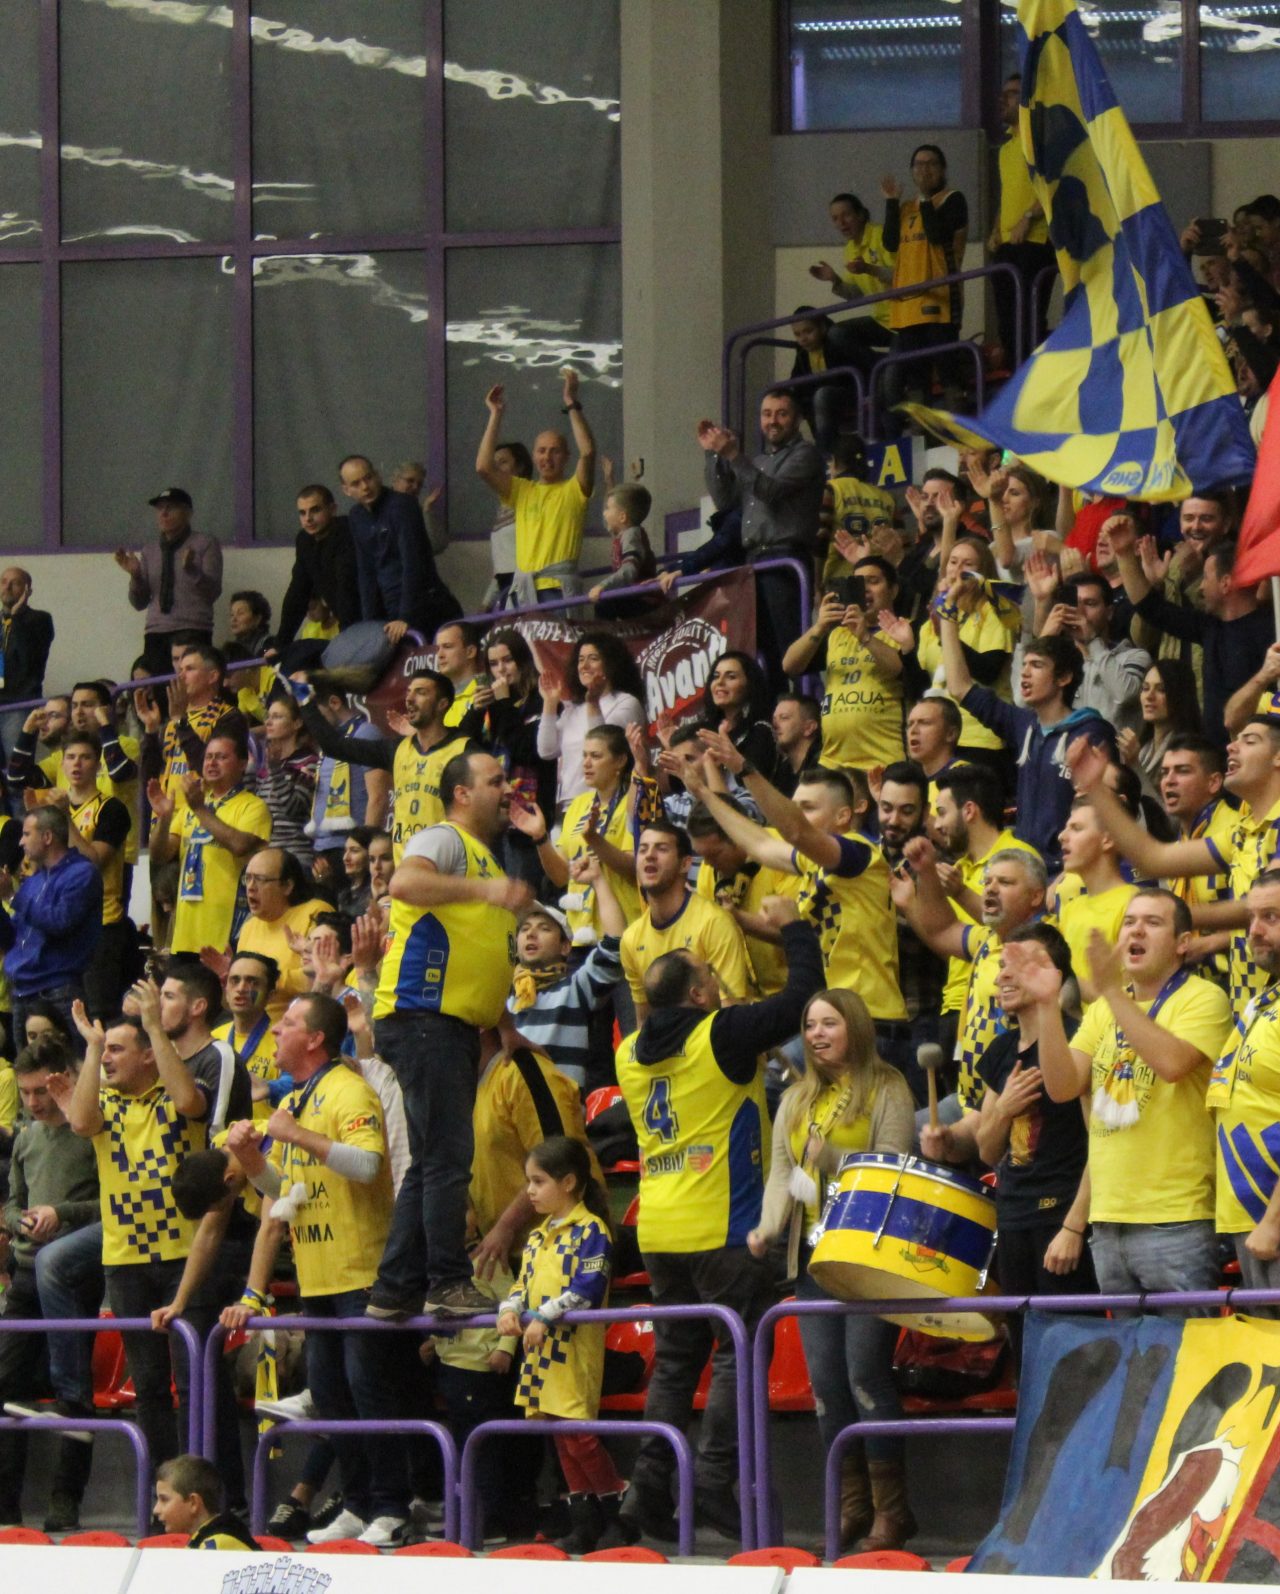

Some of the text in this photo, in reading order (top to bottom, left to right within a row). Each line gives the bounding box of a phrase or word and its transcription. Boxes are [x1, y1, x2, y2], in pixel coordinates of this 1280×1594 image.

[842, 669, 862, 685] 10
[834, 690, 885, 706] AQUA
[410, 799, 420, 816] 0
[643, 1075, 679, 1145] 4
[648, 1150, 685, 1176] SIBIU
